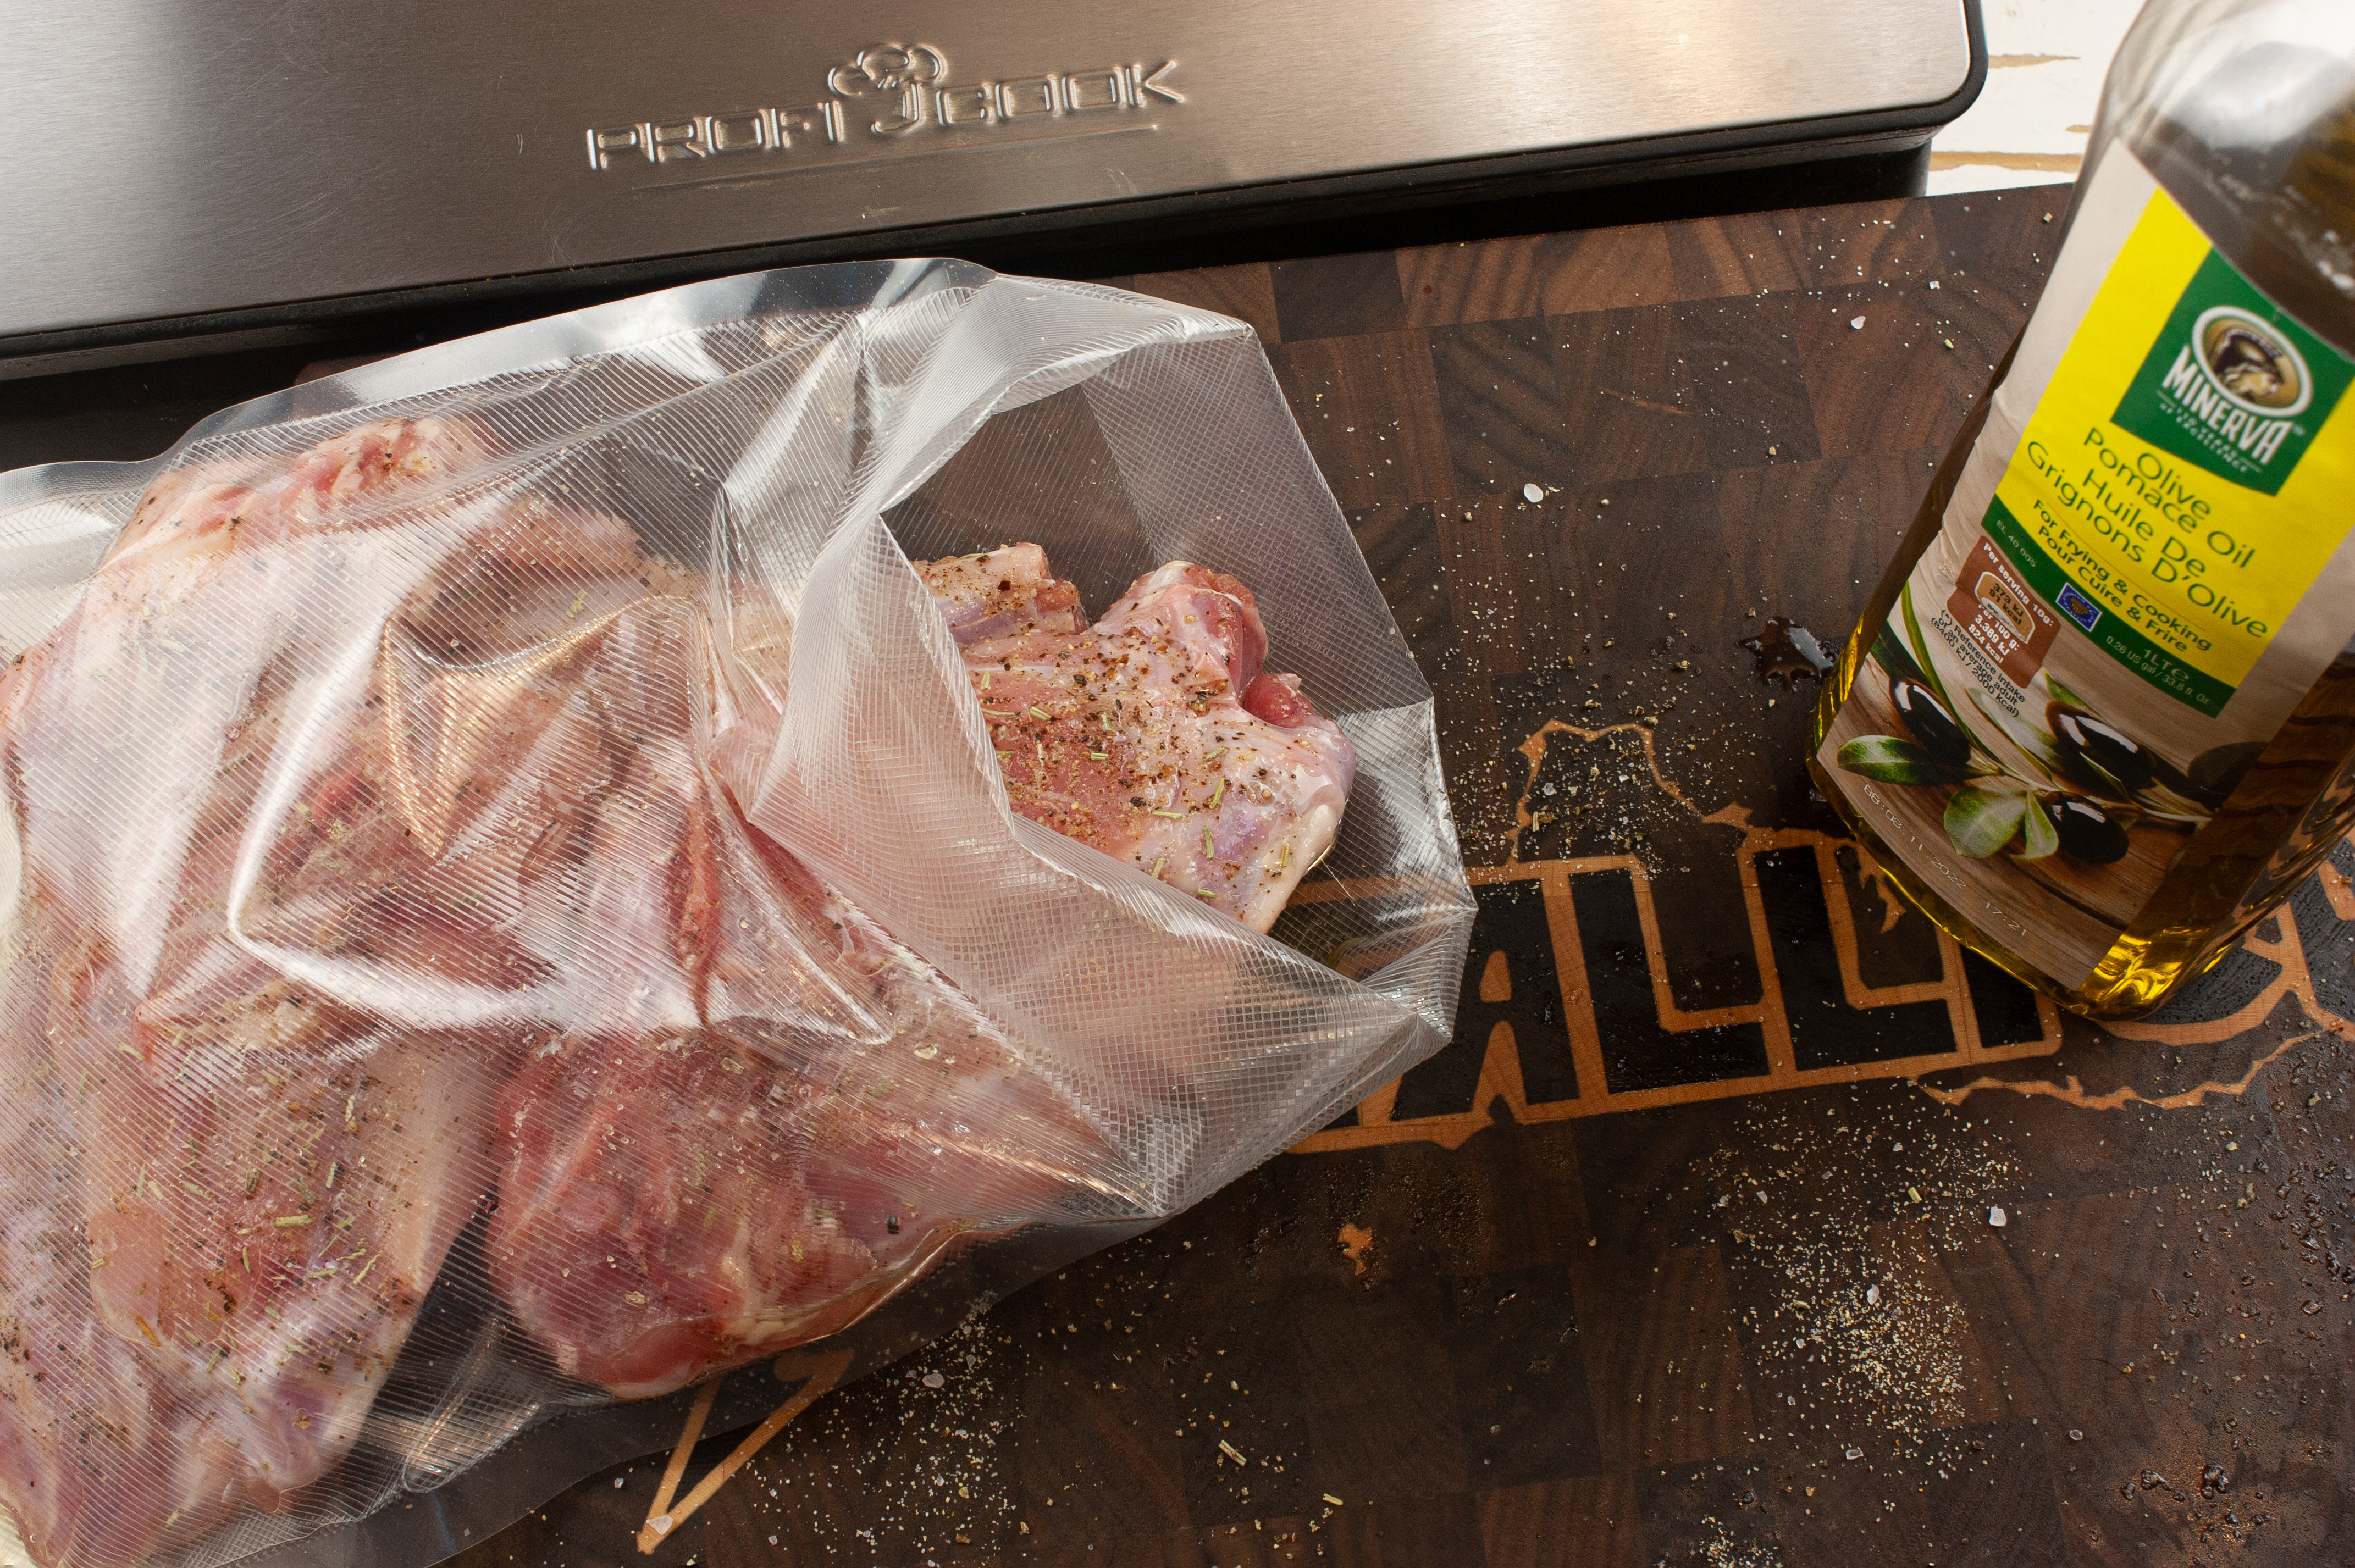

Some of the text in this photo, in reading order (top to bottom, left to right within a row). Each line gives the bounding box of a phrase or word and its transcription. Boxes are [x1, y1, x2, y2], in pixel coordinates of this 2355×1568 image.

[2162, 344, 2294, 466] MINERVA
[2083, 469, 2207, 577] Huile De
[2084, 427, 2255, 568] Pomace Oil
[2137, 453, 2211, 520] Olive
[1997, 520, 2036, 567] EL 40 005
[2028, 441, 2146, 562] Grignons
[2152, 557, 2268, 638] D'Olive
[2033, 500, 2058, 528] For
[2060, 529, 2110, 581] Frying
[2114, 579, 2128, 595] &
[2133, 594, 2212, 651] Cooking
[1983, 542, 1999, 563] Per
[1998, 564, 2030, 605] serving
[2032, 603, 2054, 627] 10g:
[1989, 588, 2001, 603] 91
[2002, 604, 2023, 625] kcal
[1993, 583, 2011, 603] 373
[2013, 604, 2024, 617] kJ
[2038, 525, 2075, 564] Pour
[2078, 567, 2122, 607] Cuire
[2127, 607, 2141, 622] &
[2146, 619, 2187, 652] Frire
[1932, 618, 1955, 647] (8400
[1956, 646, 1966, 661] kJ
[1972, 668, 1995, 694] 2000
[1996, 693, 2020, 718] kcal)
[1948, 630, 1958, 644] an
[1960, 644, 1993, 682] average
[1994, 682, 2018, 706] adult
[1954, 625, 1997, 674] Reference
[1998, 673, 2026, 702] intake
[1969, 624, 1985, 644] 824
[1984, 642, 2003, 663] kcal
[1975, 614, 1999, 643] 3.389
[1998, 641, 2010, 656] kJ
[1994, 620, 2010, 639] 100
[2009, 639, 2020, 651] g:
[2106, 635, 2127, 654] 0.26
[2127, 651, 2141, 664] US
[2141, 662, 2157, 674] gal
[2162, 674, 2185, 691] 33.8
[2197, 694, 2210, 705] Oz
[1985, 902, 2027, 937] 17:21
